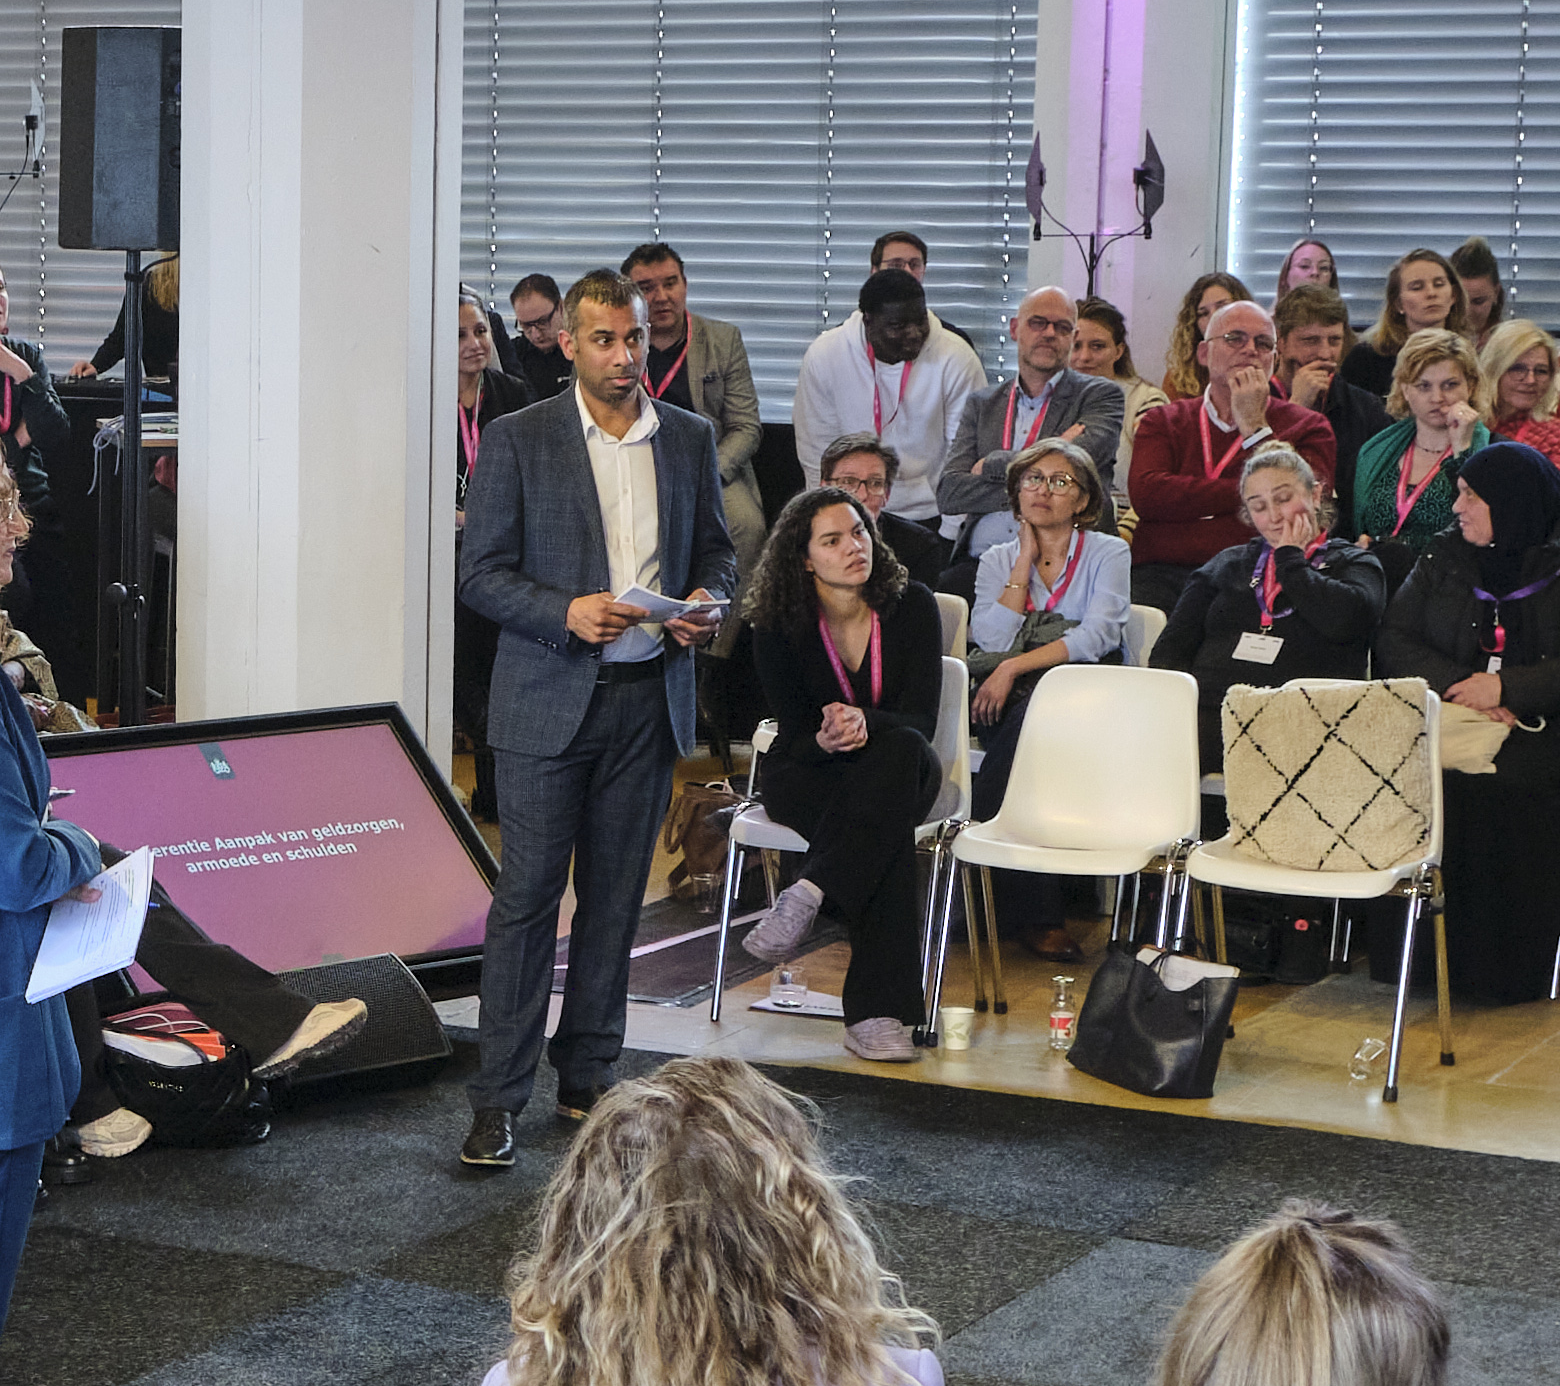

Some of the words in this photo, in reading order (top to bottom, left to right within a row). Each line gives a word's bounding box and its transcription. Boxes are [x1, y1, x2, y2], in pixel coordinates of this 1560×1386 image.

[214, 830, 277, 852] Aanpak
[277, 829, 309, 843] van
[311, 817, 405, 842] geldzorgen,
[185, 852, 261, 873] armoede
[261, 851, 284, 864] en
[285, 841, 358, 861] schulden
